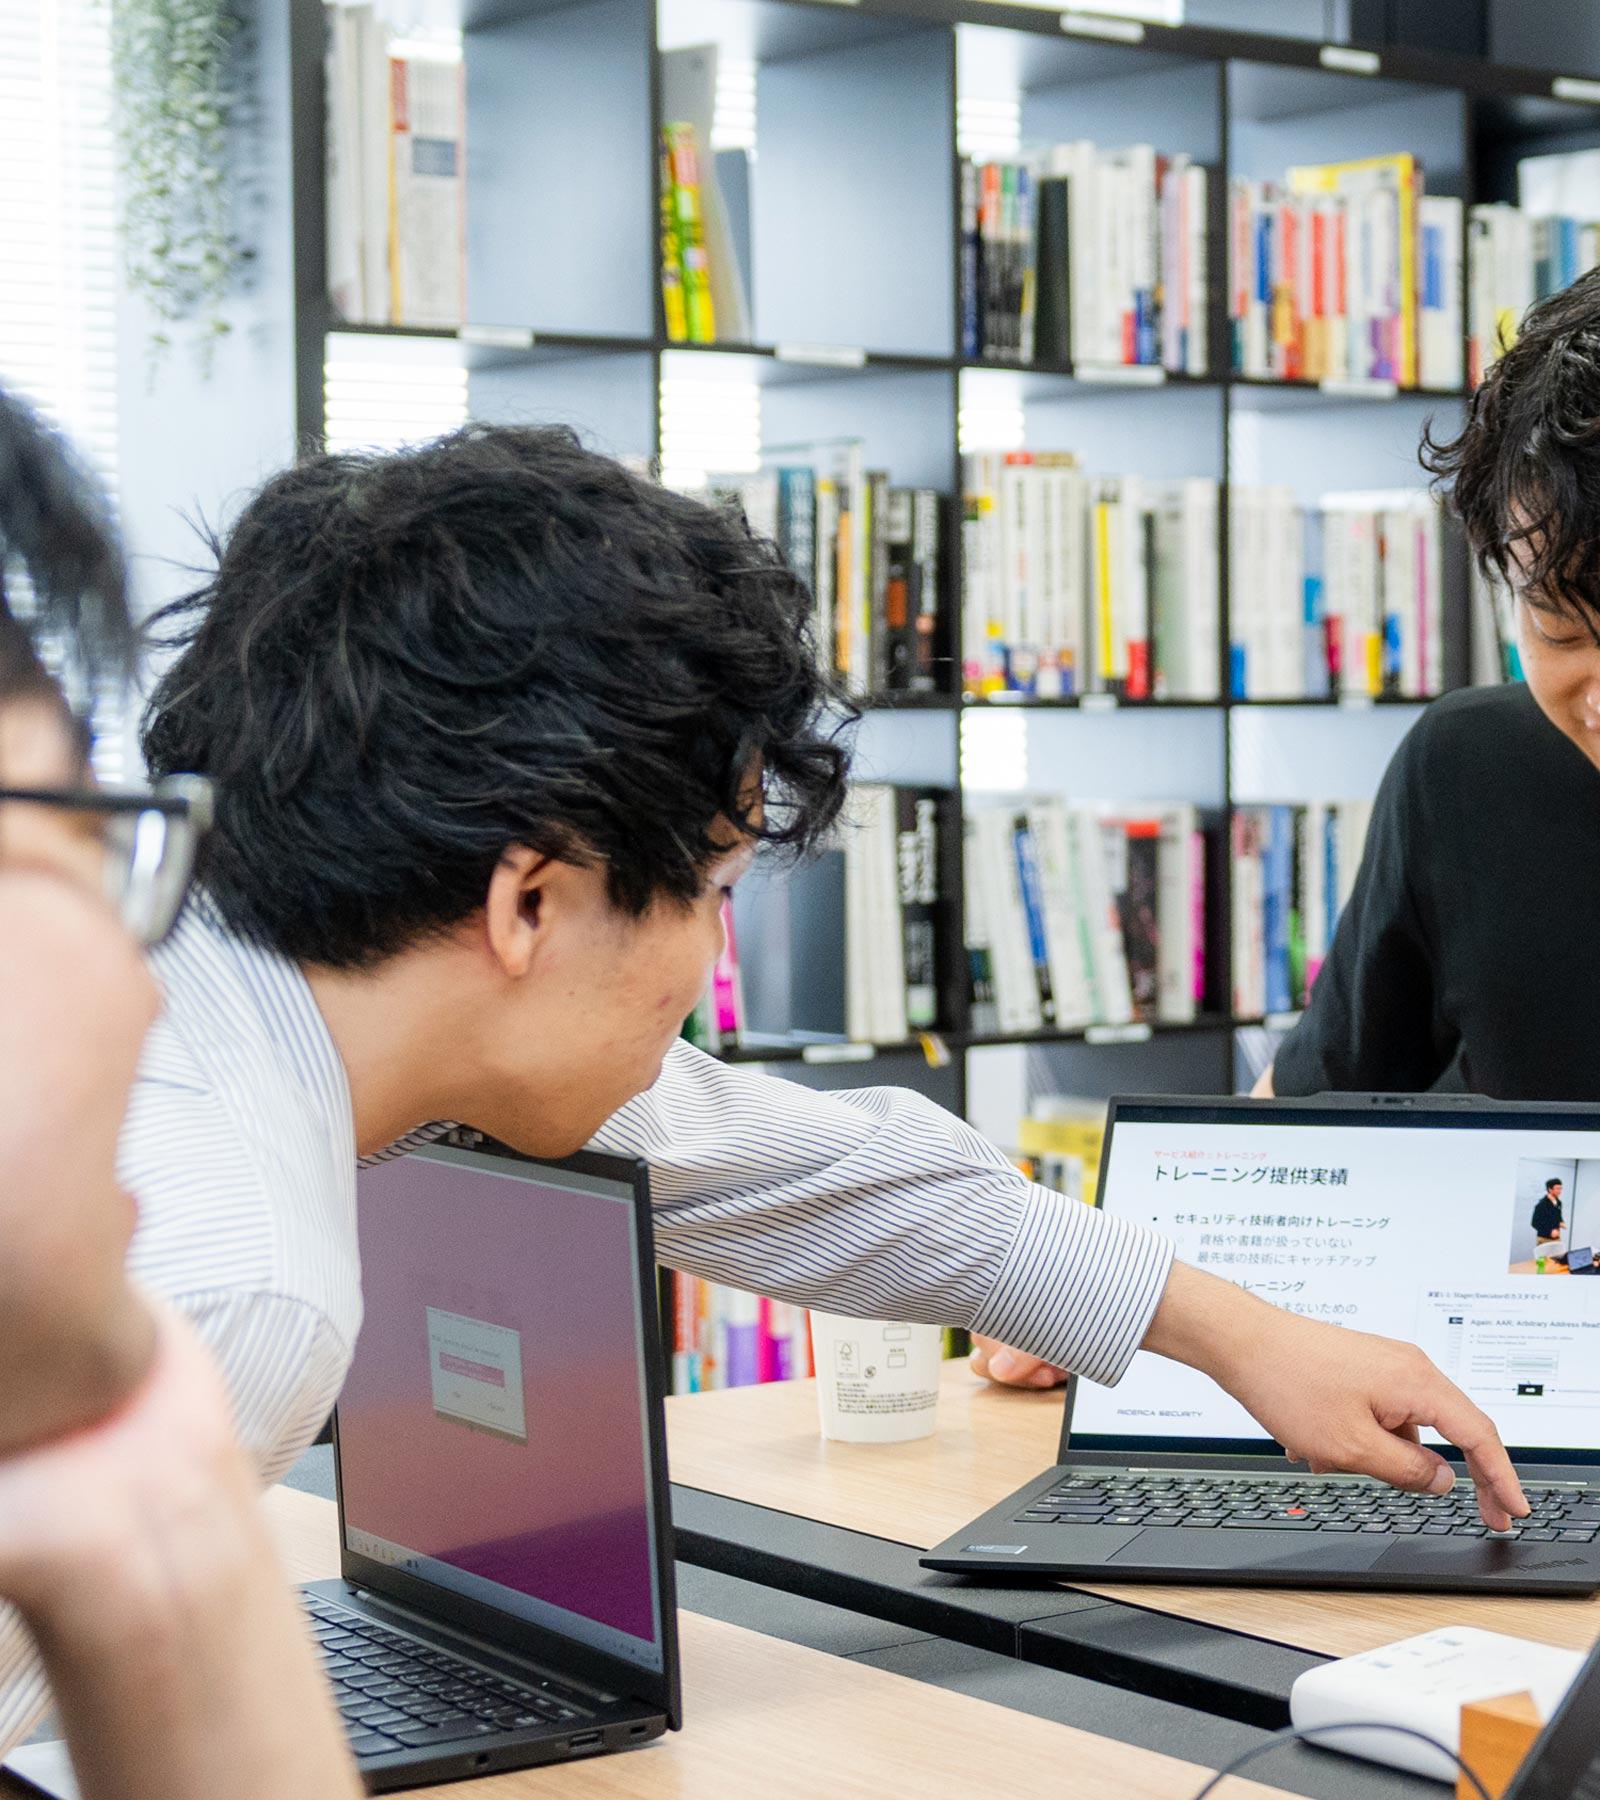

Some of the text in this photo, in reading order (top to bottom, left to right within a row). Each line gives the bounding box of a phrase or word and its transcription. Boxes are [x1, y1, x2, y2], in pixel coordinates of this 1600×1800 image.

[1155, 1164, 1348, 1186] トレーニング提供実績
[1174, 1213, 1391, 1229] セキュリティ技術者向けトレーニング
[1200, 1234, 1353, 1249] 資格や書籍が扱っていない
[1197, 1251, 1378, 1267] 最先端の技術にキャッチアップ
[1549, 1321, 1580, 1329] Address
